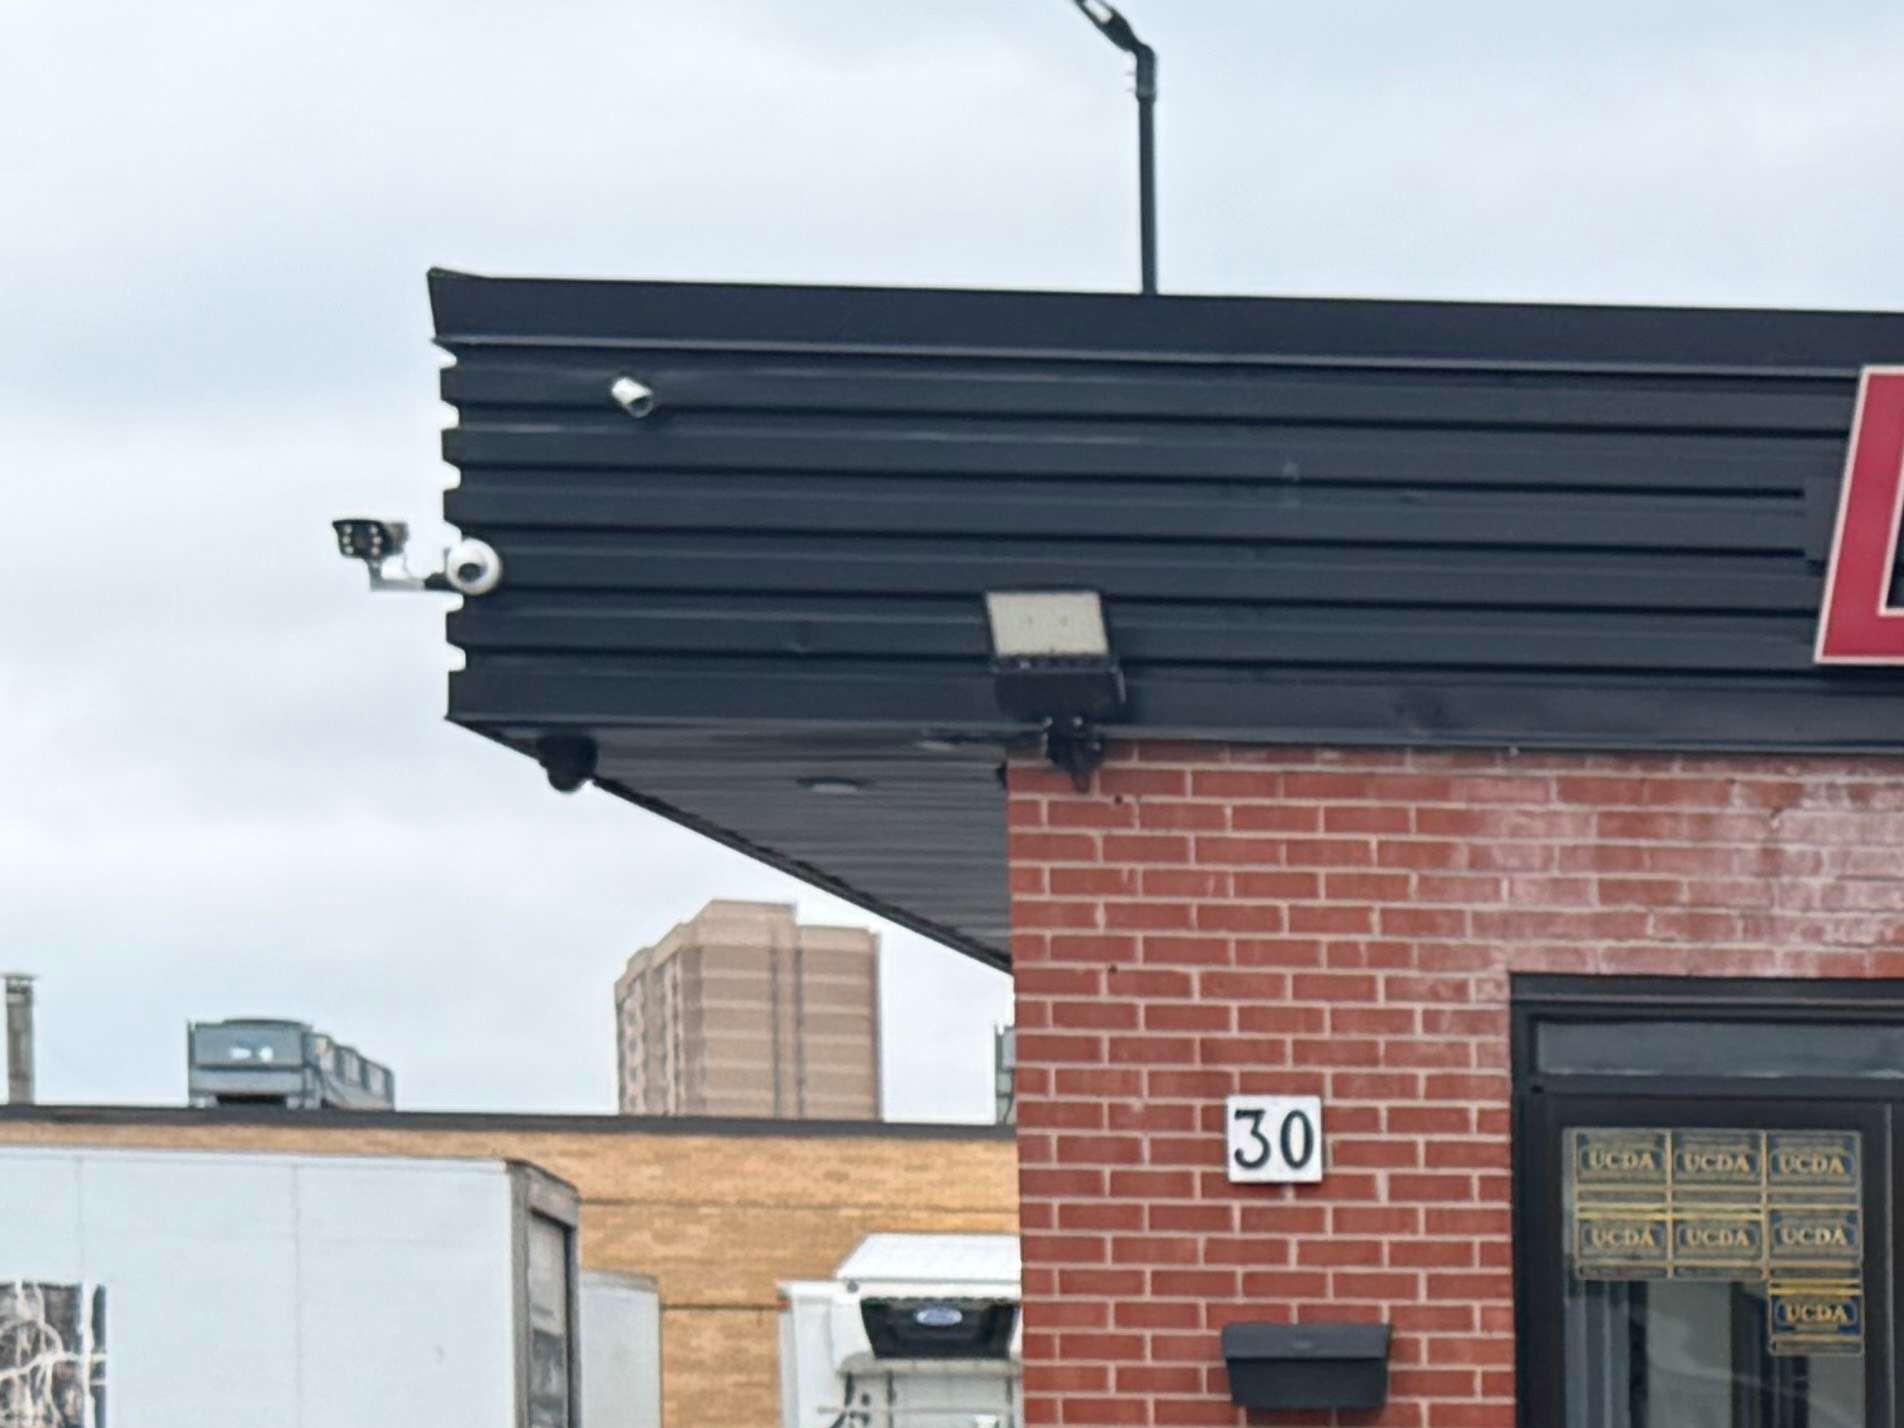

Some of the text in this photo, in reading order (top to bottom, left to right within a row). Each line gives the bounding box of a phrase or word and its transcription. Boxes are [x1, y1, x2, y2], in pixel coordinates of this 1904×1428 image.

[1233, 1108, 1314, 1170] 30
[1588, 1150, 1656, 1171] UCDA
[1684, 1152, 1751, 1173] UCDA
[1778, 1152, 1847, 1175] UCDA
[1591, 1228, 1656, 1248] UCDA
[1686, 1228, 1751, 1247] UCDA
[1780, 1227, 1849, 1246] UCDA
[1785, 1303, 1849, 1323] UCDA
